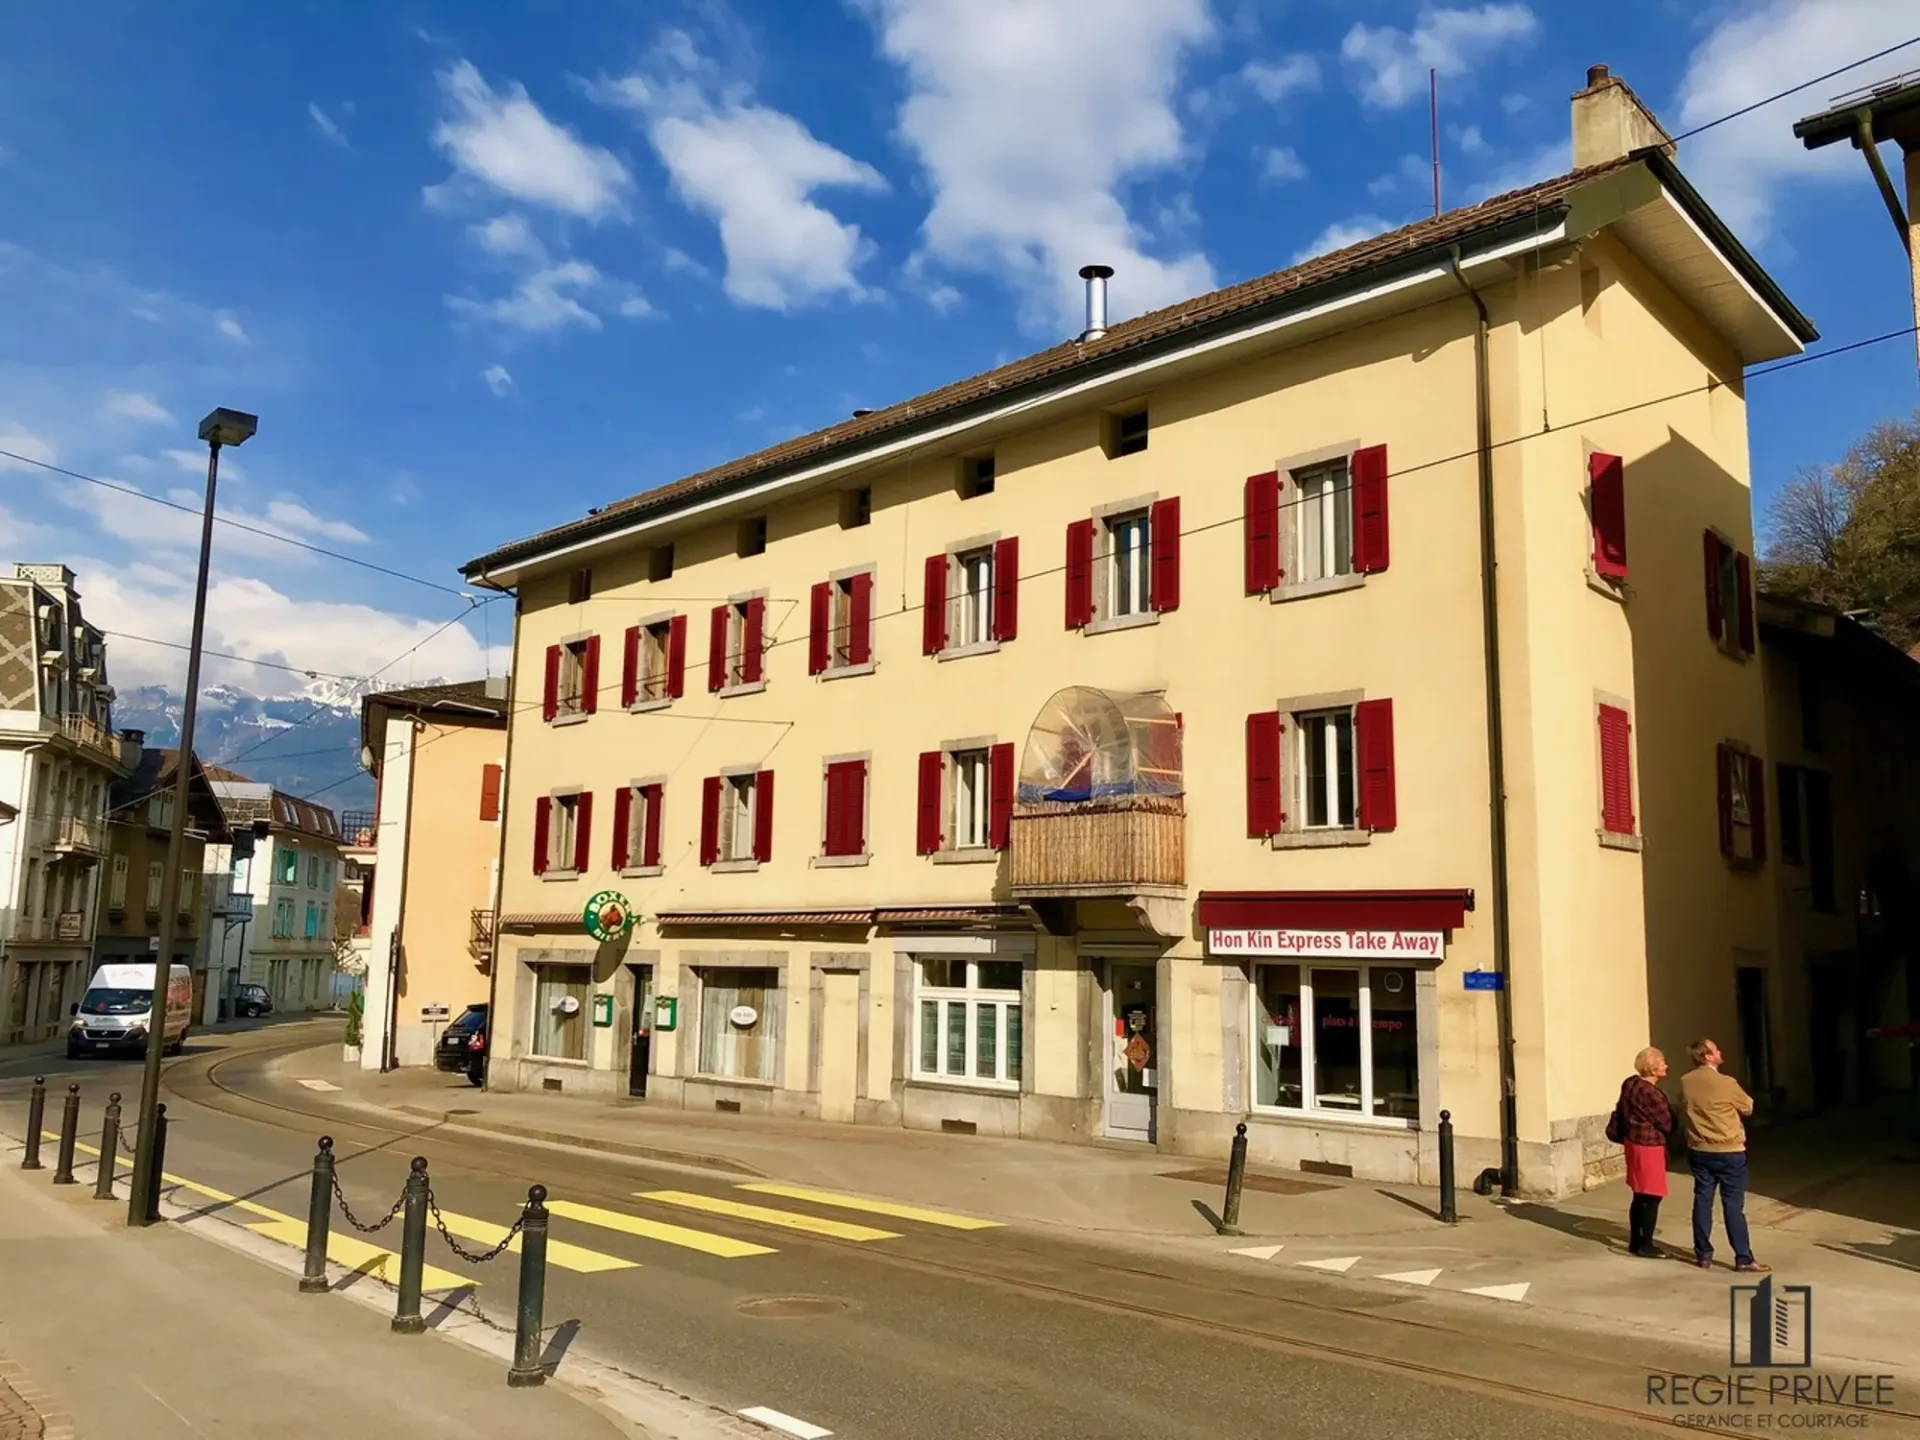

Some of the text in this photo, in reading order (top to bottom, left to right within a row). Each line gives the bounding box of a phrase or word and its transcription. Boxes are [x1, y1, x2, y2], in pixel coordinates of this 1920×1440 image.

[588, 891, 632, 913] BOXER
[1212, 930, 1440, 955] Hon Kin Express Take Away
[1321, 1013, 1346, 1030] plats
